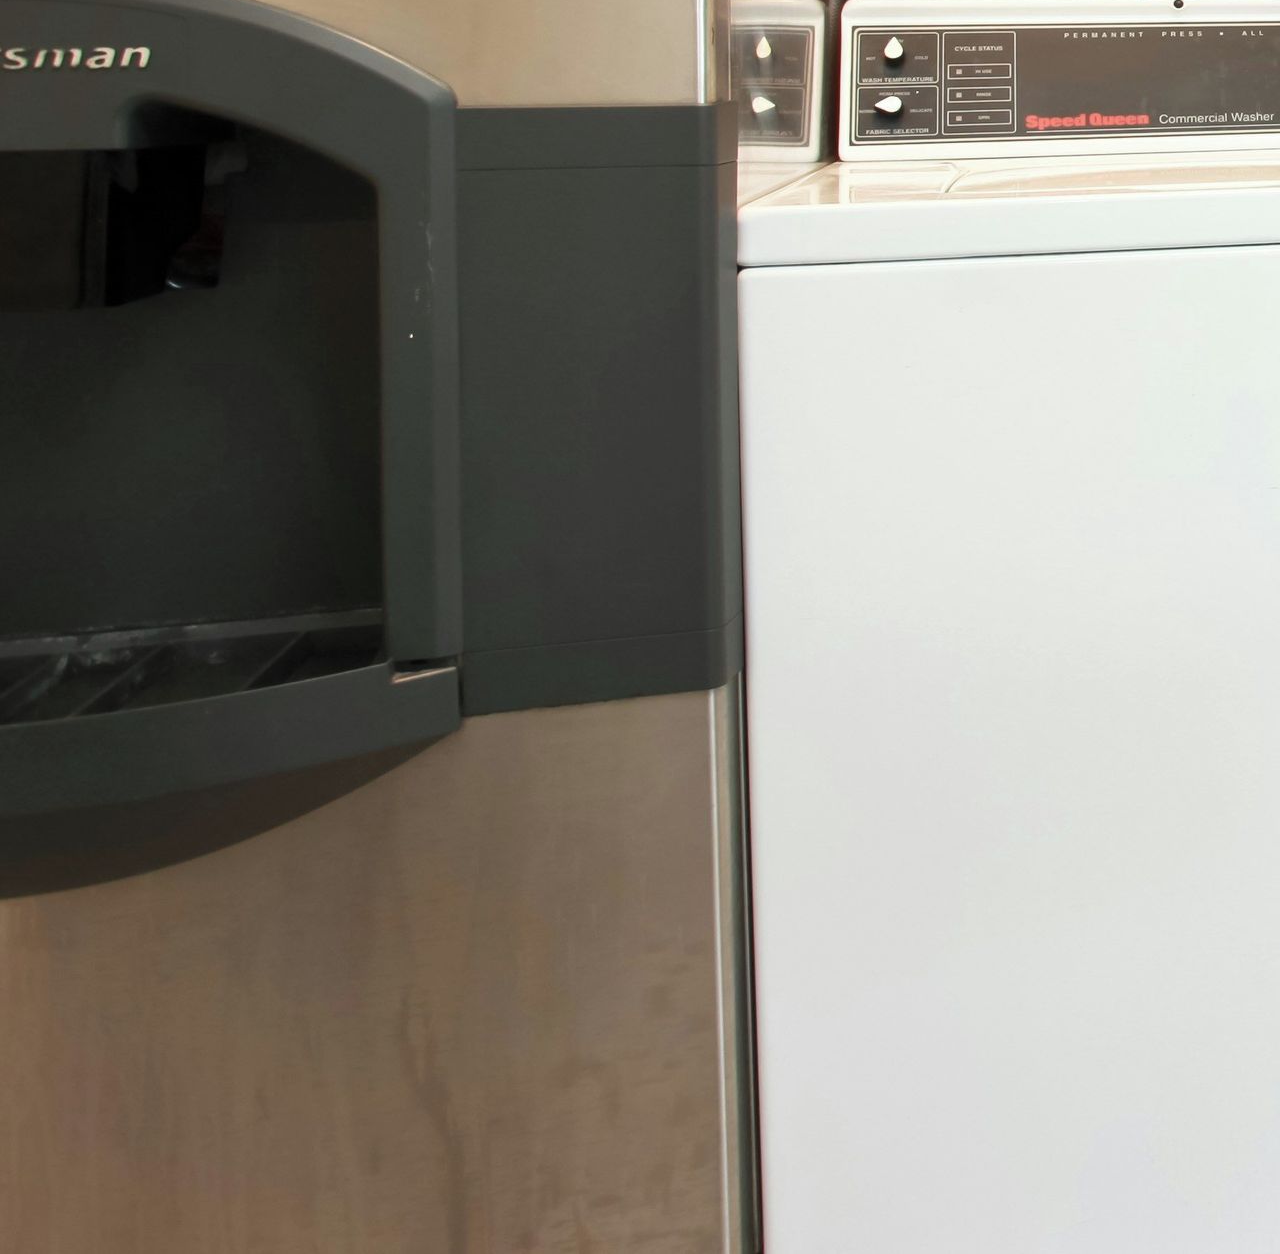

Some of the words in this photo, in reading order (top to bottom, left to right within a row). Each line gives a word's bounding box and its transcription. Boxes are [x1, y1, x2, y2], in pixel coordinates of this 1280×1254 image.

[1063, 31, 1144, 39] PERMANENT
[1161, 30, 1203, 38] PRESS
[0, 46, 151, 70] sman
[1025, 113, 1087, 131] Speed
[1089, 112, 1150, 127] Queen
[1158, 112, 1228, 125] Commercial
[1231, 111, 1275, 123] Washer
